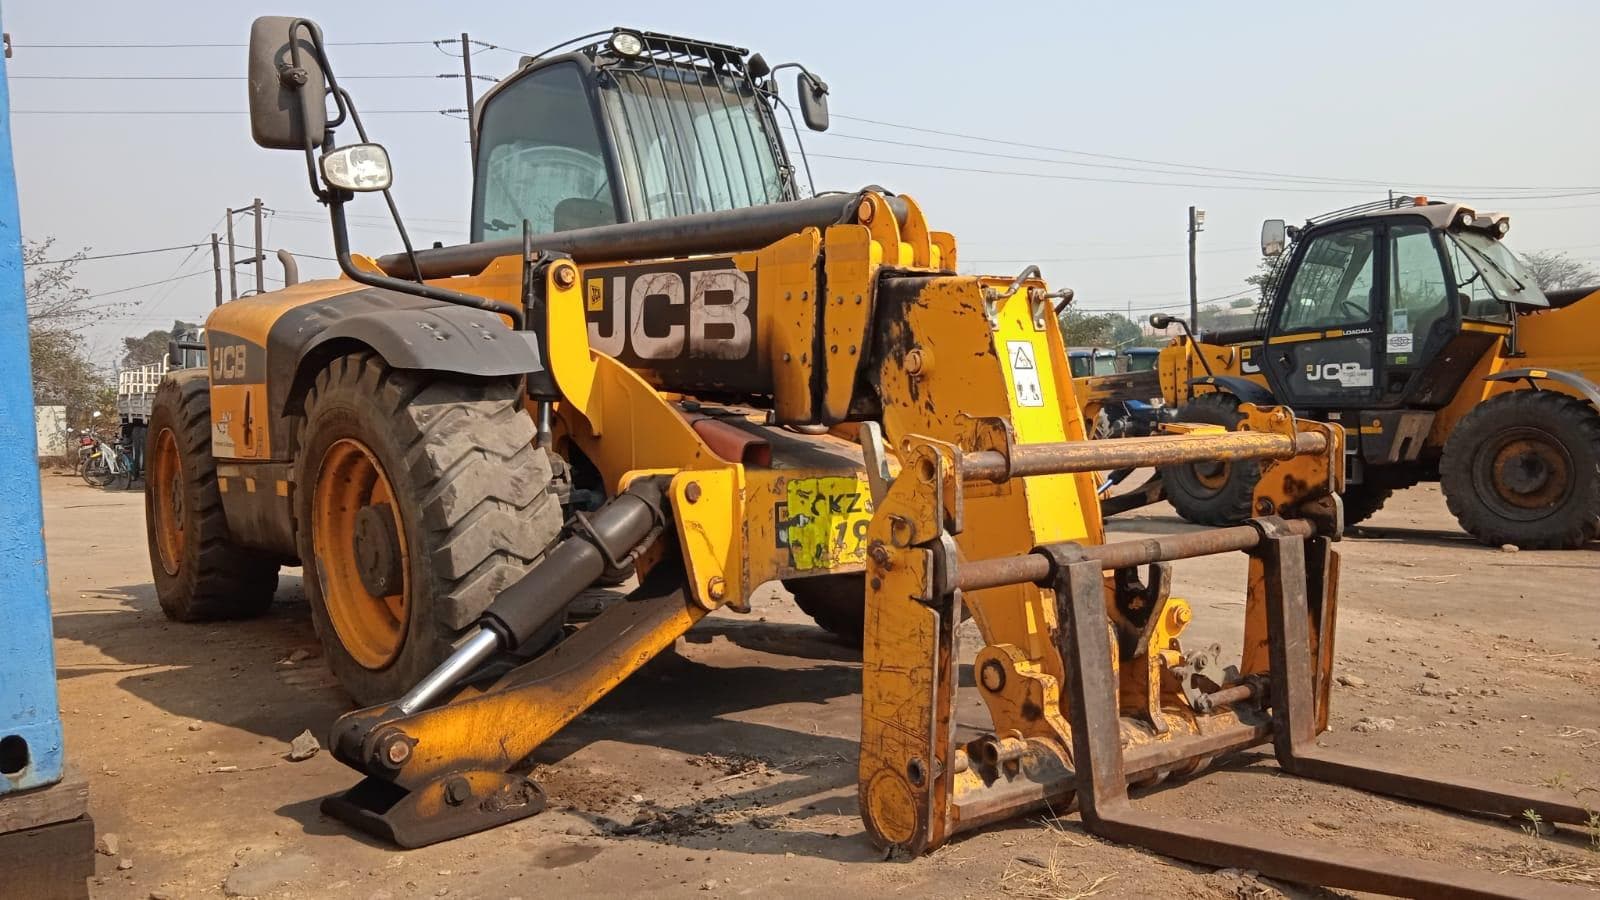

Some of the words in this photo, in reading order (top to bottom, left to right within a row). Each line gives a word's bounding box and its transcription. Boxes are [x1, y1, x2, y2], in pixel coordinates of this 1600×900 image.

[588, 269, 751, 360] JCB
[1342, 327, 1374, 336] LOADALL
[213, 345, 247, 379] JCB
